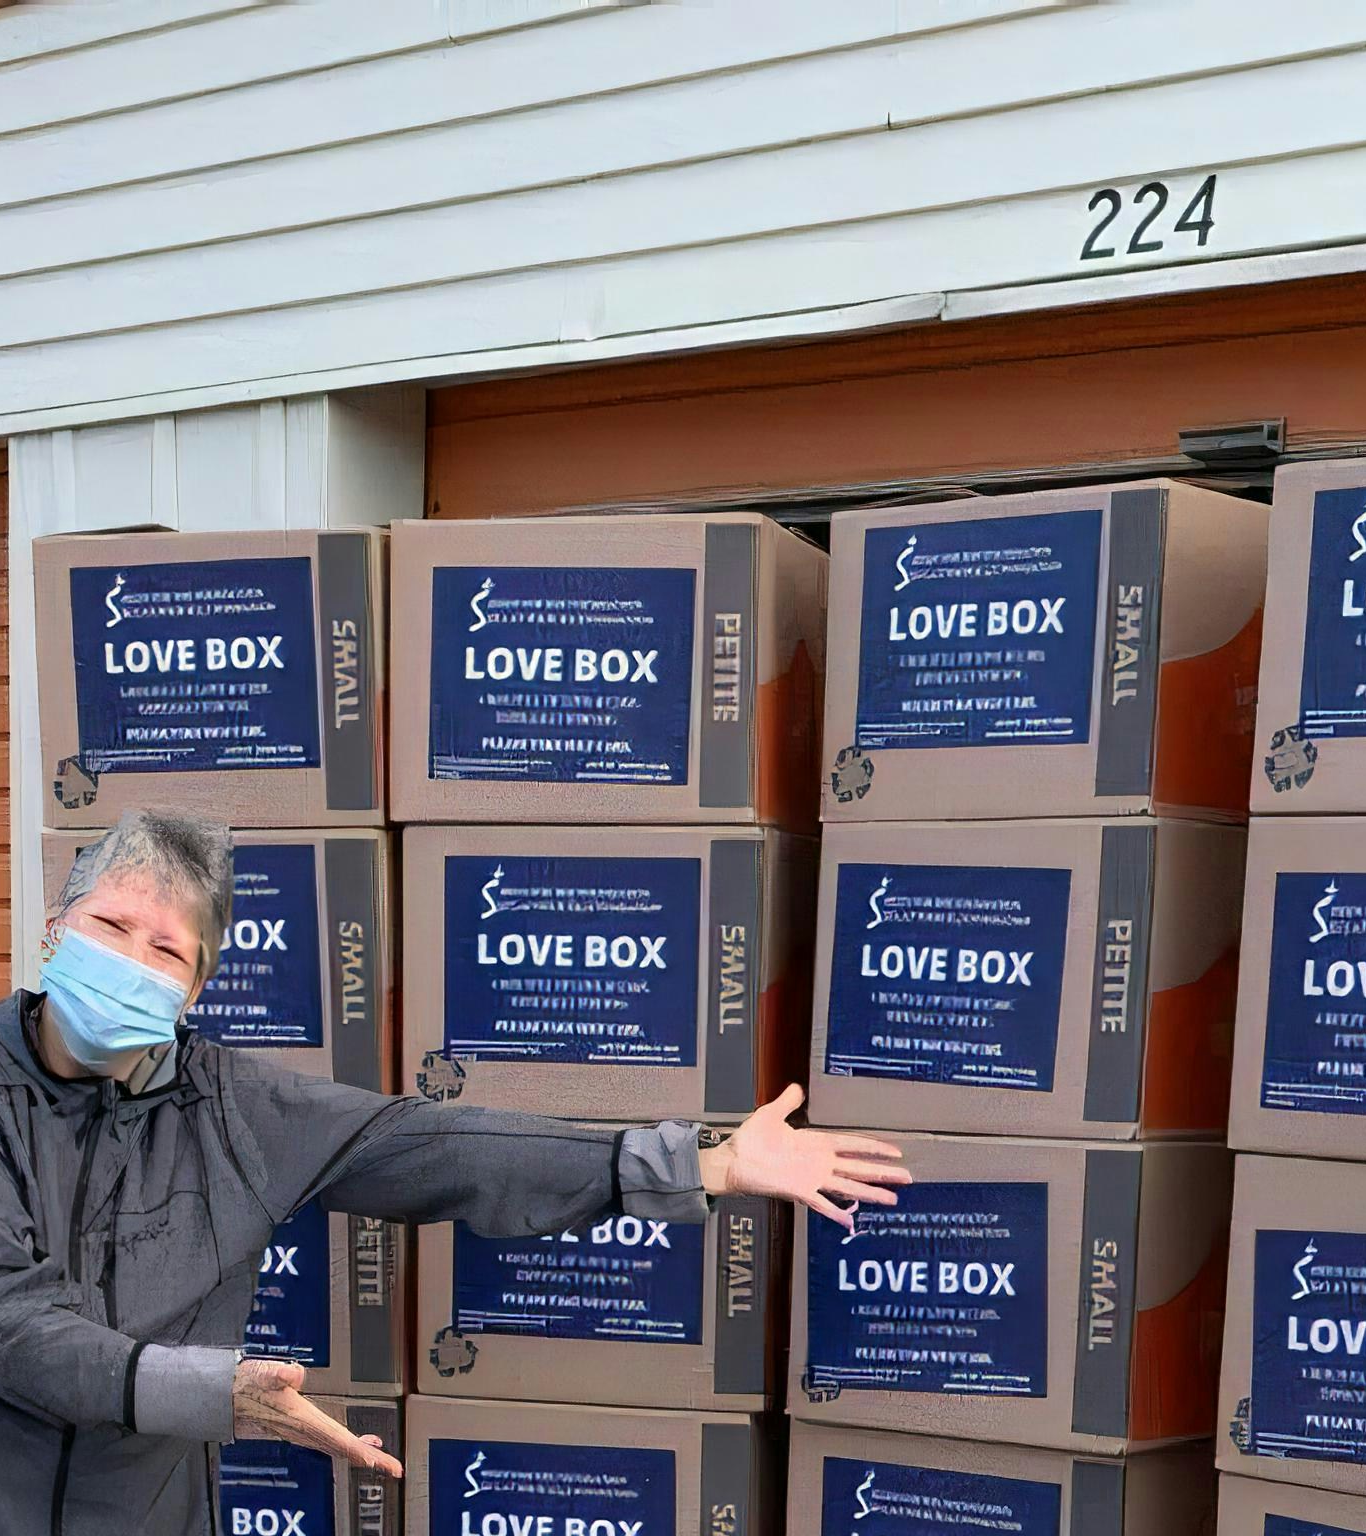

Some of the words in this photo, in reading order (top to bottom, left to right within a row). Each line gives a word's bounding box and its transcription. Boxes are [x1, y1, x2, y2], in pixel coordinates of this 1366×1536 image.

[1080, 174, 1217, 261] 224
[104, 638, 195, 674] LOVE
[206, 636, 284, 672] BOX
[465, 647, 563, 682] LOVE
[574, 648, 658, 684] BOX
[889, 603, 977, 641] LOVE
[986, 597, 1066, 636] BOX
[1112, 584, 1144, 706] SMALL
[331, 620, 361, 729] SMALL
[713, 613, 742, 723] PETITE
[338, 921, 365, 1025] SMALL
[477, 933, 574, 968] LOVE
[584, 934, 667, 970] BOX
[718, 925, 745, 1035] SMALL
[861, 944, 948, 982] LOVE
[956, 949, 1034, 986] BOX
[1101, 919, 1133, 1034] PETITE
[838, 1260, 928, 1293] LOVE
[939, 1262, 1016, 1297] BOX
[1088, 1238, 1117, 1351] SMALL
